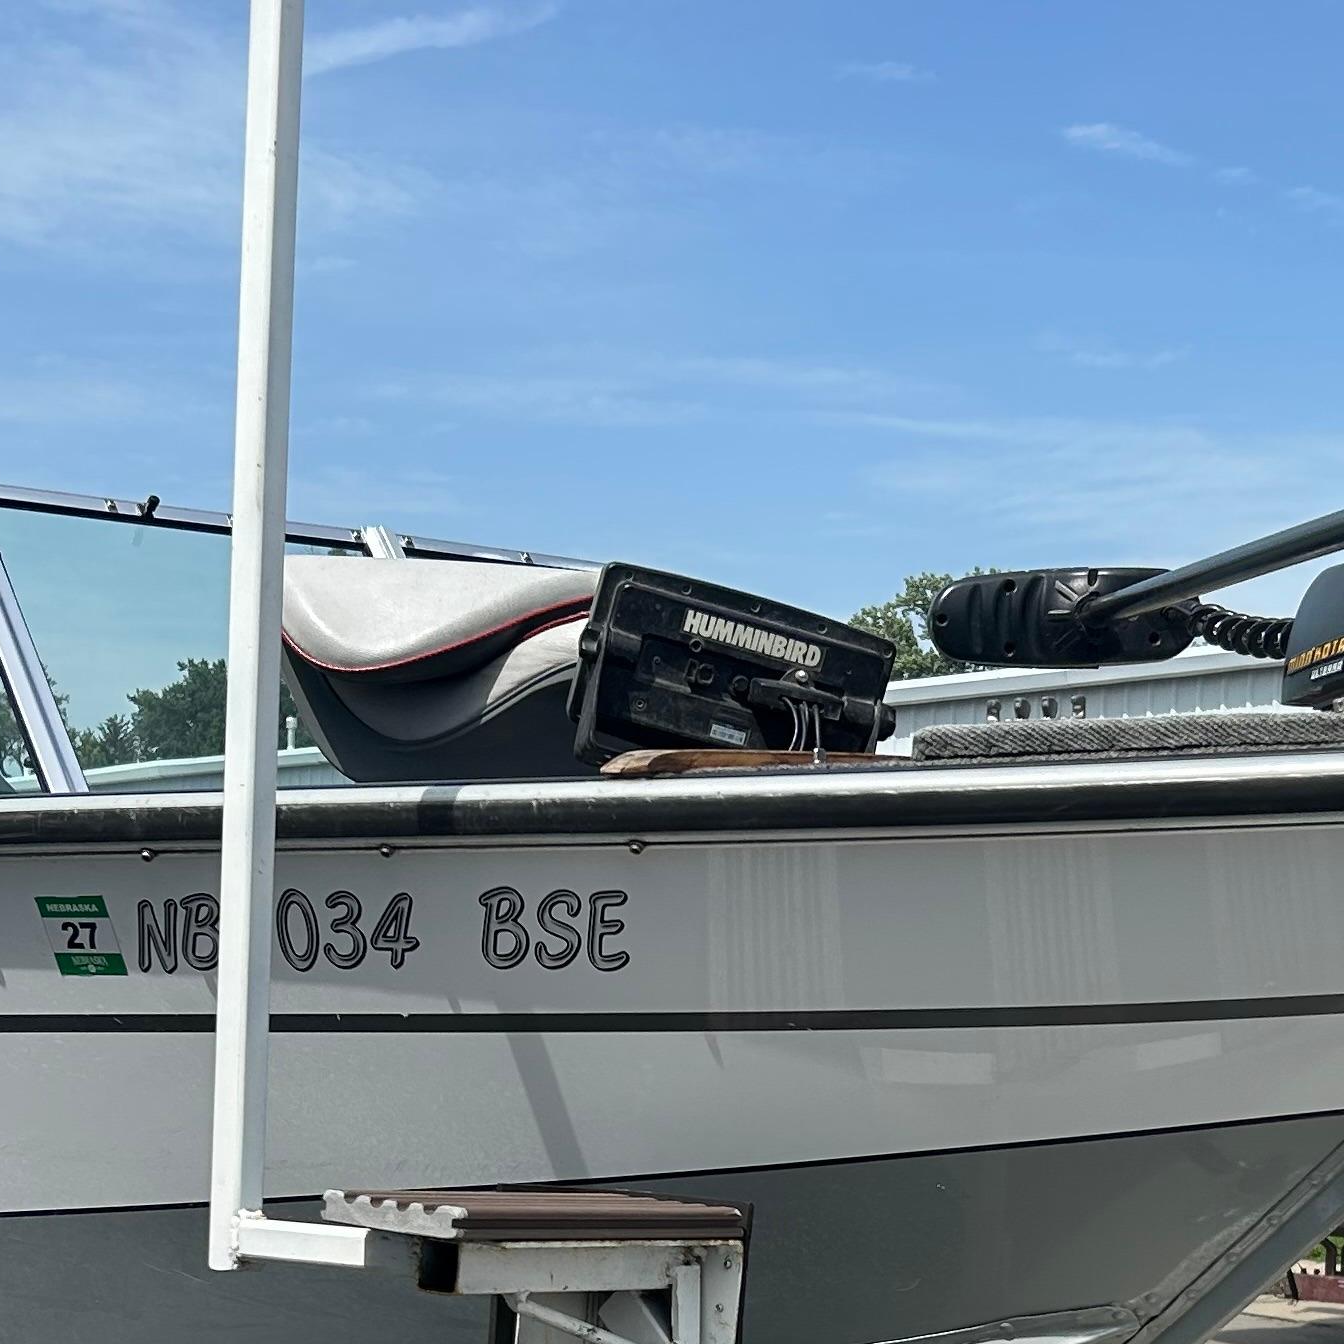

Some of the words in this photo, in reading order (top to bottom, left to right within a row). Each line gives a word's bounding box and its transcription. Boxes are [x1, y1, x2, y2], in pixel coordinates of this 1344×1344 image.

[682, 609, 822, 668] HUMMINBIRD
[45, 903, 99, 912] NEBRASKA
[61, 921, 97, 950] 27
[137, 893, 221, 974] NB
[276, 888, 421, 972] 034
[479, 886, 631, 972] BSE
